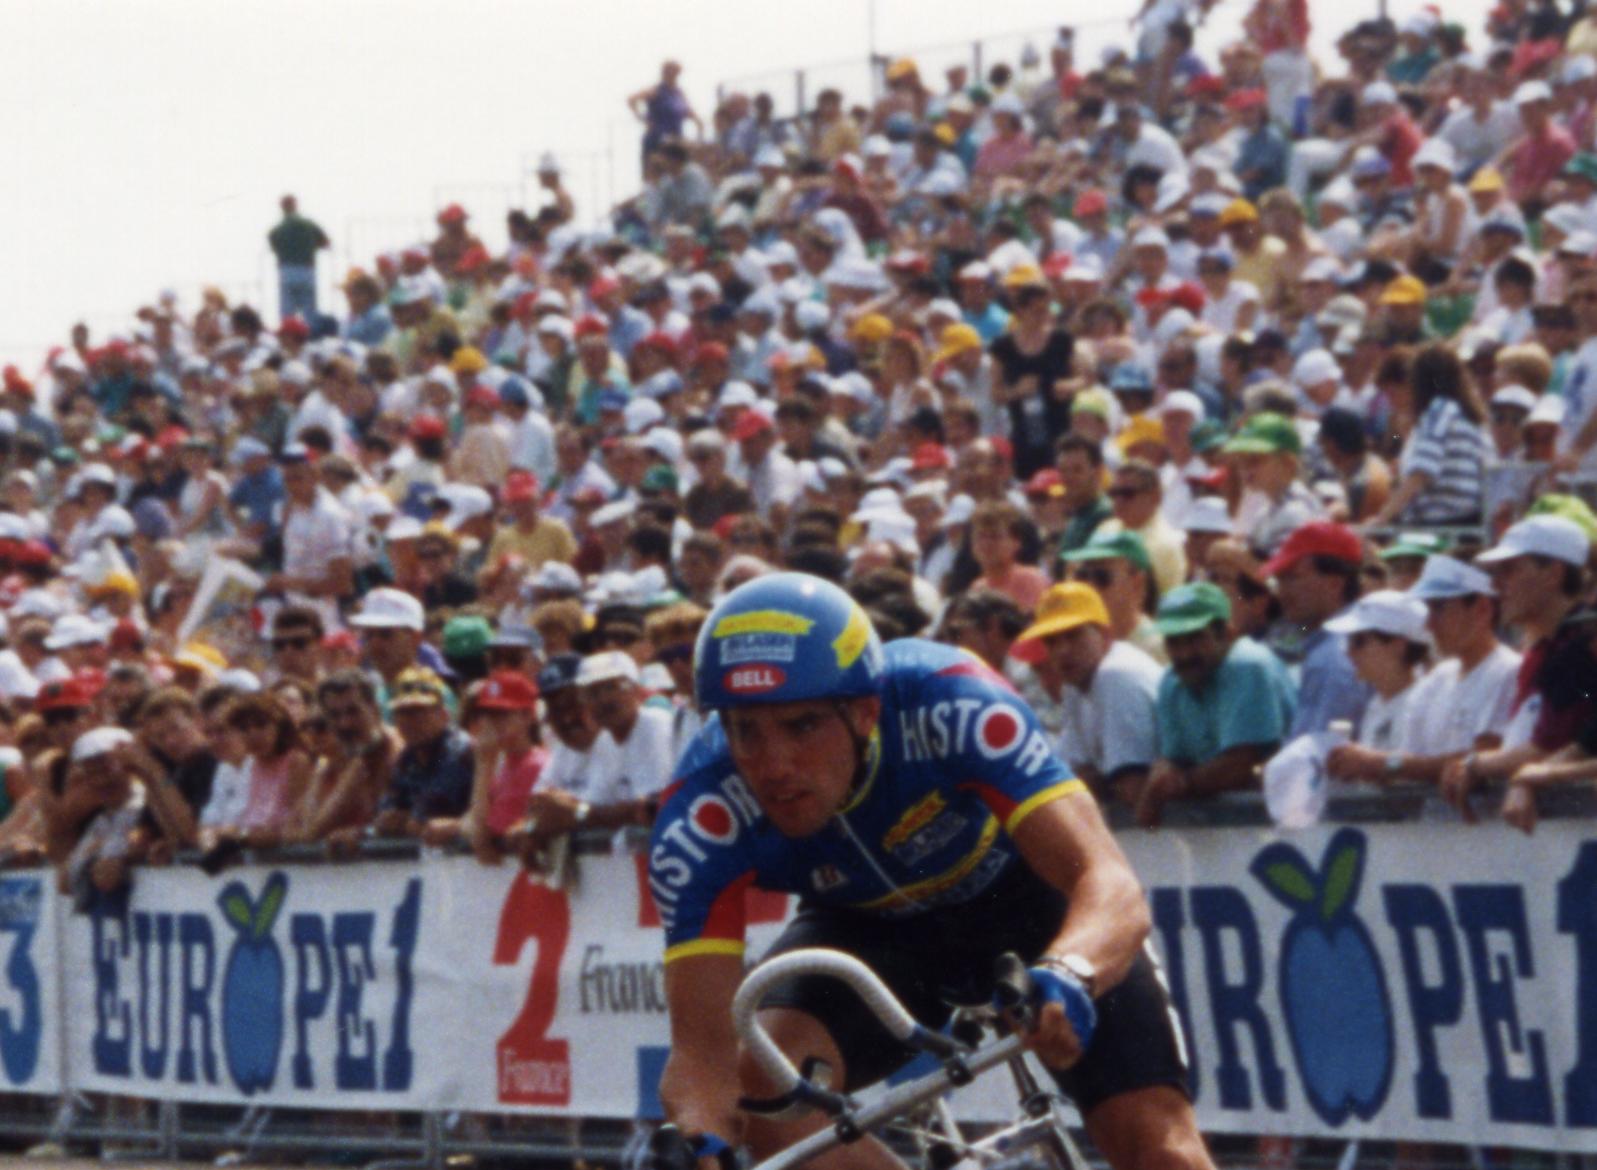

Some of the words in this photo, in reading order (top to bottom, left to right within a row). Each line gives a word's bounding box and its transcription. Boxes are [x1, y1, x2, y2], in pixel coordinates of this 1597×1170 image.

[731, 671, 776, 688] BELL
[900, 698, 1051, 778] HISTOR
[492, 867, 571, 1106] 2
[579, 944, 668, 1014] Franc
